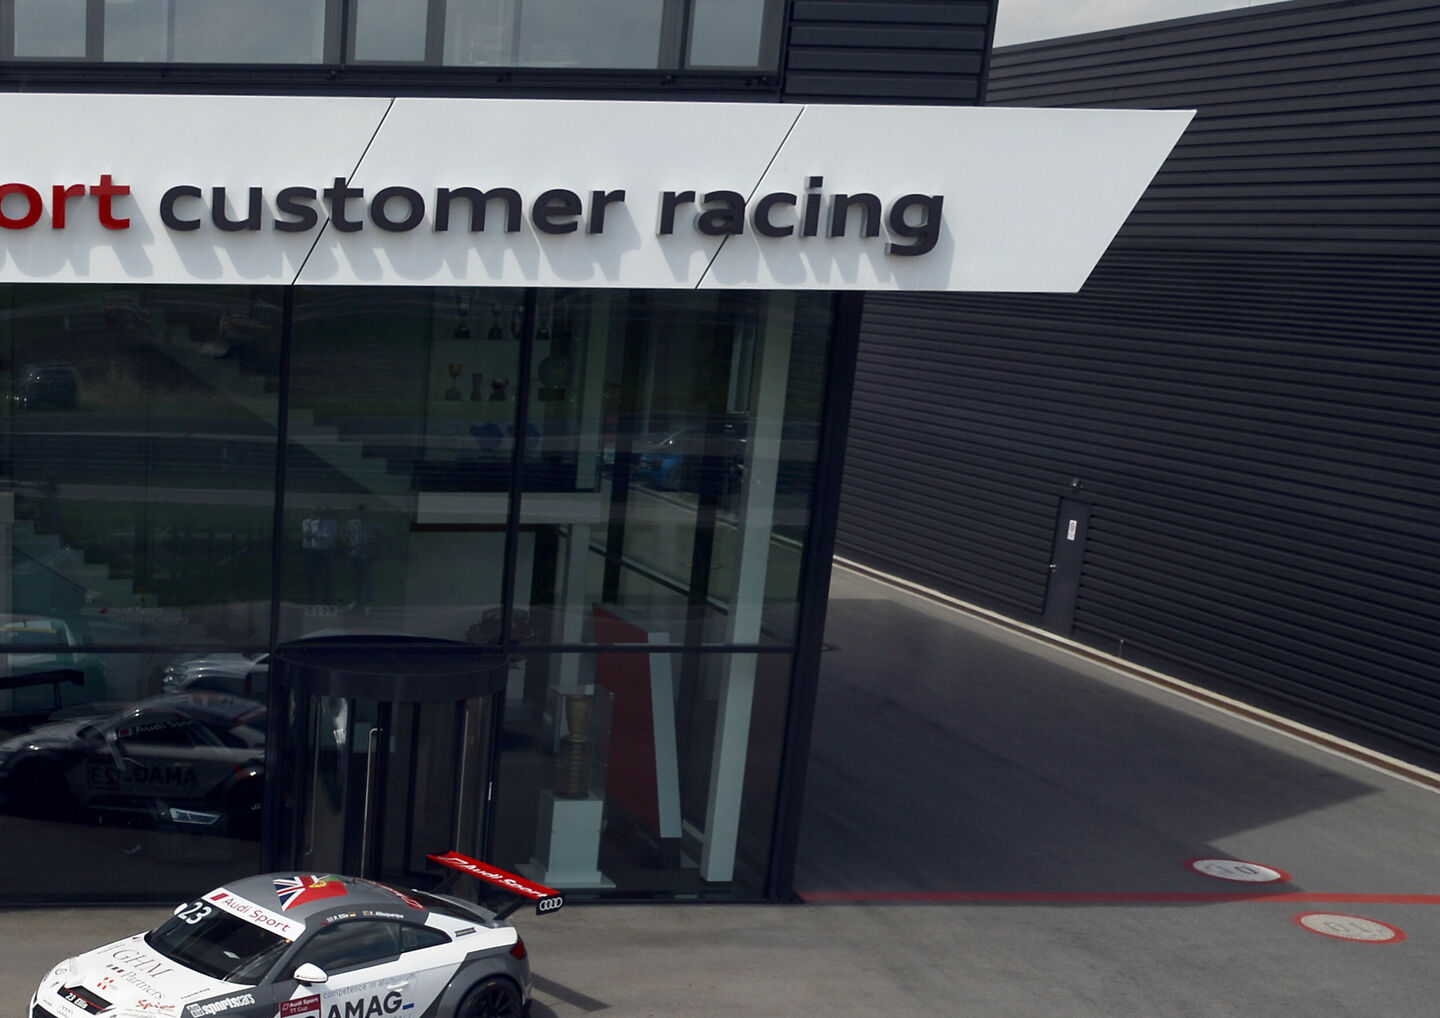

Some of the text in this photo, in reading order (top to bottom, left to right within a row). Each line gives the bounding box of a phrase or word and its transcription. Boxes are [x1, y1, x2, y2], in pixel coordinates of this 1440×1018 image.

[159, 180, 625, 234] customer
[657, 175, 944, 256] racing
[177, 901, 212, 925] 23
[224, 898, 291, 933] Audi Sport
[112, 949, 175, 979] GHM
